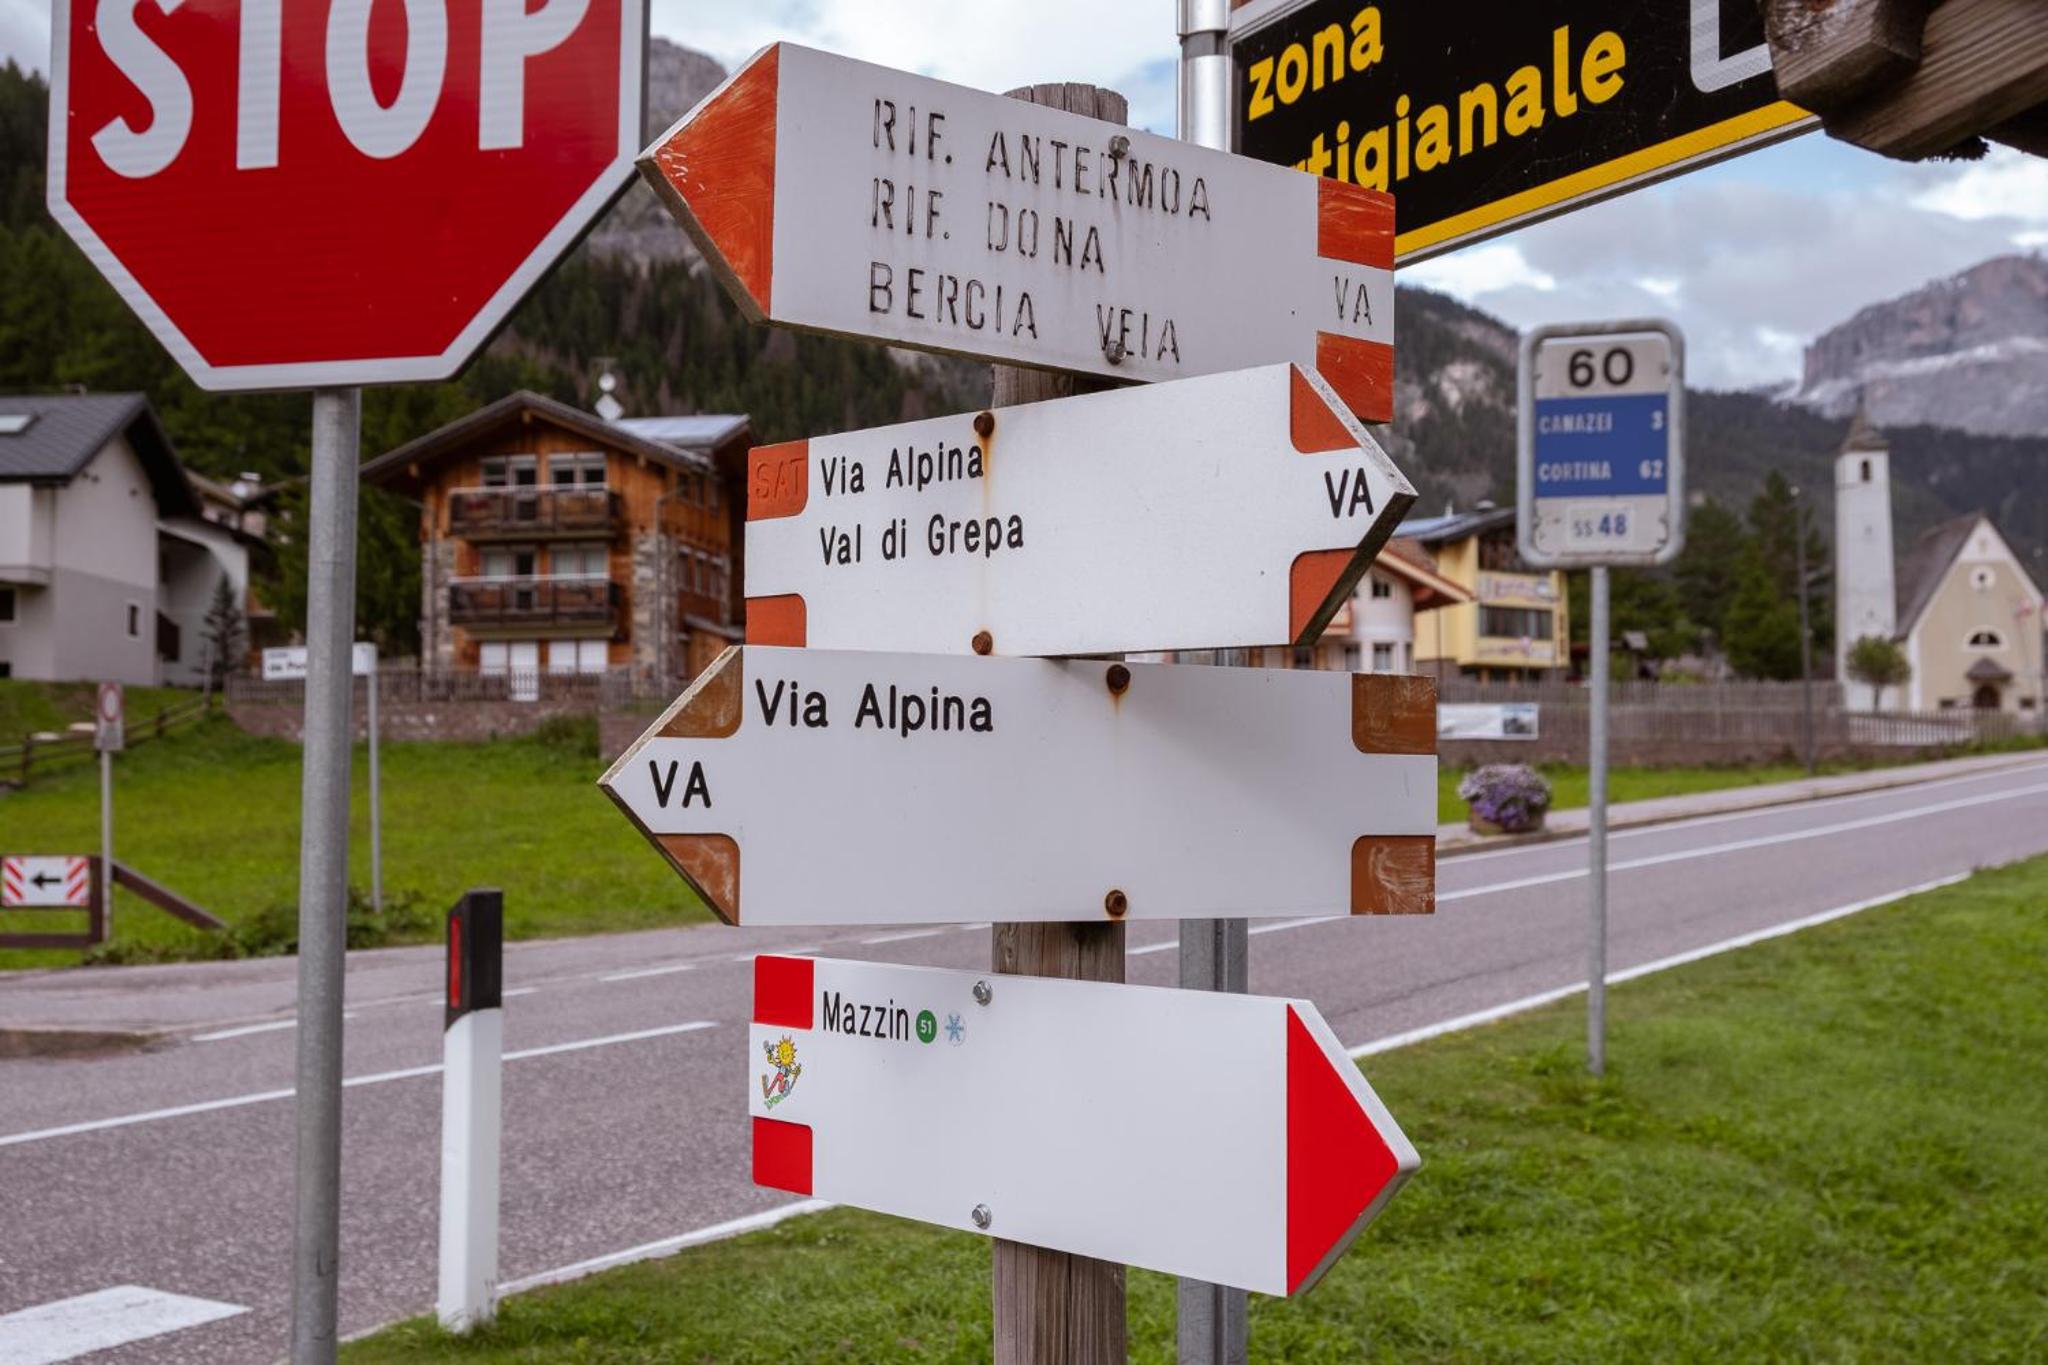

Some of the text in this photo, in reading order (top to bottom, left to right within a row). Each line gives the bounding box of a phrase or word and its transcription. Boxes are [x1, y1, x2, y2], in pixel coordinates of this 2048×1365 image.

[1248, 6, 1384, 121] zona
[1289, 30, 1626, 193] tigianale
[873, 99, 1211, 221] RIF. ANTERMOA
[872, 178, 1104, 273] RIF. DONA
[870, 261, 1180, 363] BERCIA VEIA
[1334, 276, 1372, 326] VA
[1569, 348, 1634, 387] 60
[1539, 411, 1663, 433] CANAZEI 3
[755, 457, 807, 499] SAT
[820, 442, 984, 496] Via Alpina
[1324, 468, 1374, 519] VA
[1538, 460, 1663, 481] CORTINA 62
[820, 513, 1024, 565] Val di Grepa
[1600, 514, 1627, 535] 48
[755, 679, 993, 738] Via Alpina
[649, 760, 711, 808] VA
[823, 991, 909, 1041] Mazzin
